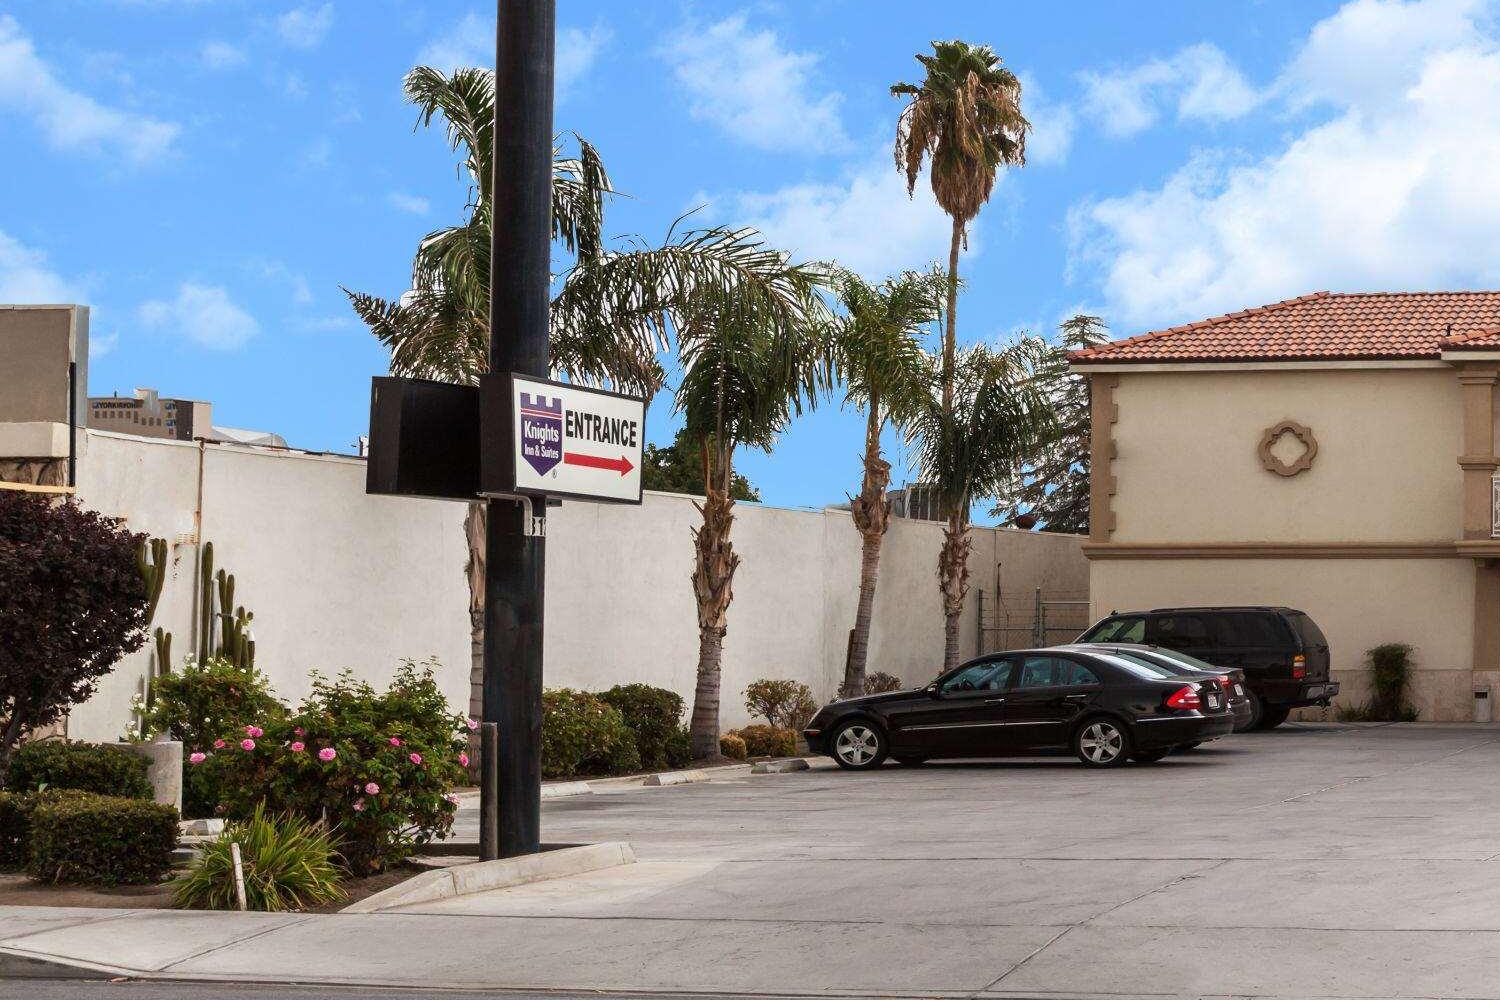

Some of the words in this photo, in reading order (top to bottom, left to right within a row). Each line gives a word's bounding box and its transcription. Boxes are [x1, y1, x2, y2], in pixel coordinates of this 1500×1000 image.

[524, 420, 559, 444] Knights
[565, 409, 637, 447] ENTRANCE
[524, 443, 534, 455] Inn
[534, 444, 540, 455] &
[540, 446, 559, 459] Suites
